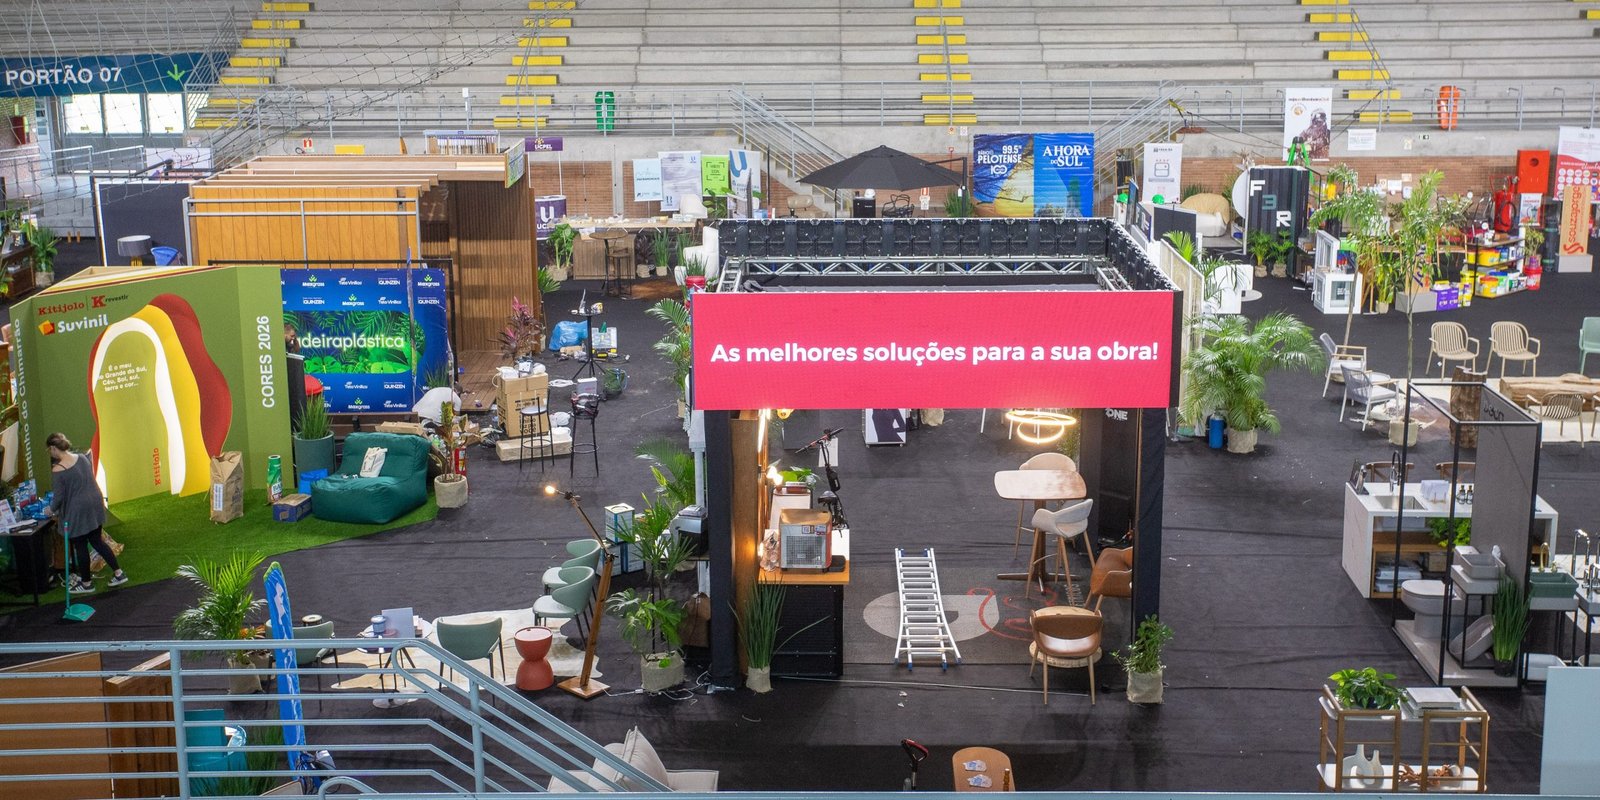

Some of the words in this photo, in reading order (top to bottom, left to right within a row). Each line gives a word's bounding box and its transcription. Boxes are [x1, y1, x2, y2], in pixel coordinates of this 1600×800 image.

[5, 64, 93, 85] PORTÃO
[99, 66, 122, 83] 07
[977, 154, 1022, 164] PELOTENSE
[1003, 145, 1019, 155] 99.5
[1043, 145, 1053, 157] A
[1054, 145, 1091, 156] HORA
[1057, 156, 1083, 167] SUL
[38, 302, 85, 316] Kitijolo
[58, 313, 109, 333] Suvinil
[257, 315, 273, 350] 2026
[298, 332, 405, 351] deiraplástica
[14, 318, 26, 397] Chimarrão
[710, 344, 741, 362] As
[746, 342, 858, 362] melhores
[863, 342, 967, 367] soluções
[972, 345, 1025, 366] para
[1030, 345, 1045, 361] a
[1050, 345, 1092, 361] sua
[1096, 341, 1159, 361] obra!
[261, 354, 275, 408] CORES
[21, 402, 28, 420] do
[23, 424, 34, 478] antinho
